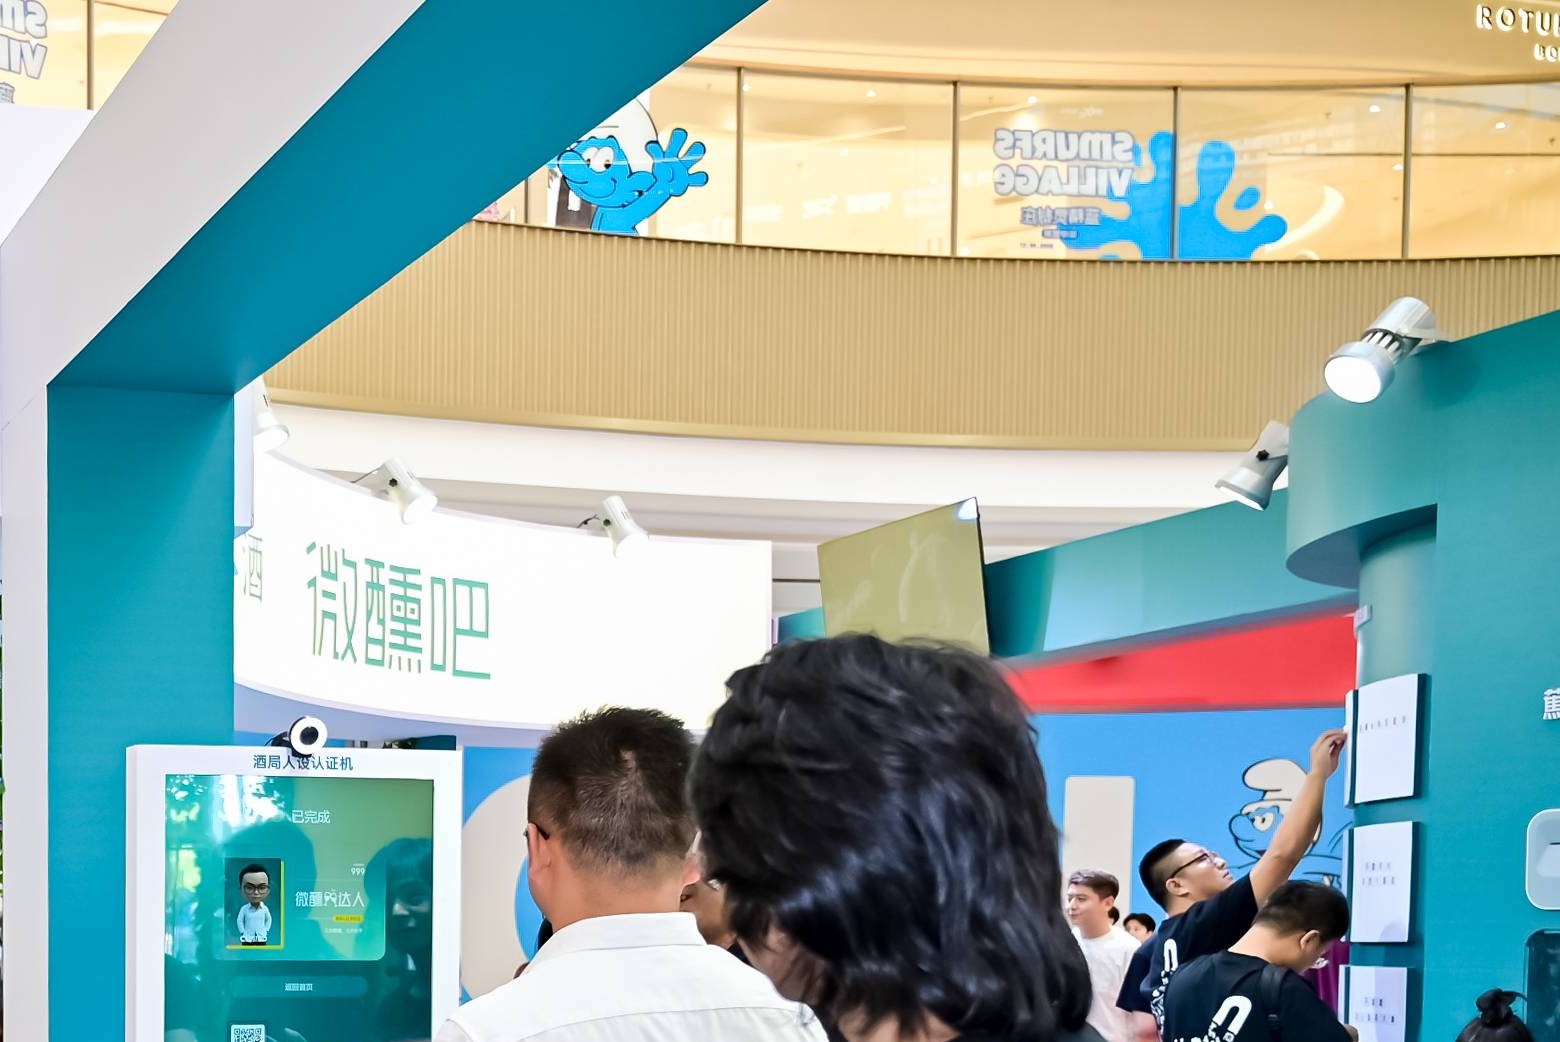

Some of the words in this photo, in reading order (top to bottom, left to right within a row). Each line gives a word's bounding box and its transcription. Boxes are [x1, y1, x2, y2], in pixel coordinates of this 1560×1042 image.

[1534, 43, 1560, 63] BO
[306, 541, 490, 680] 微醺吧
[253, 754, 354, 771] 酒局人设认证机
[292, 809, 331, 824] 已完成
